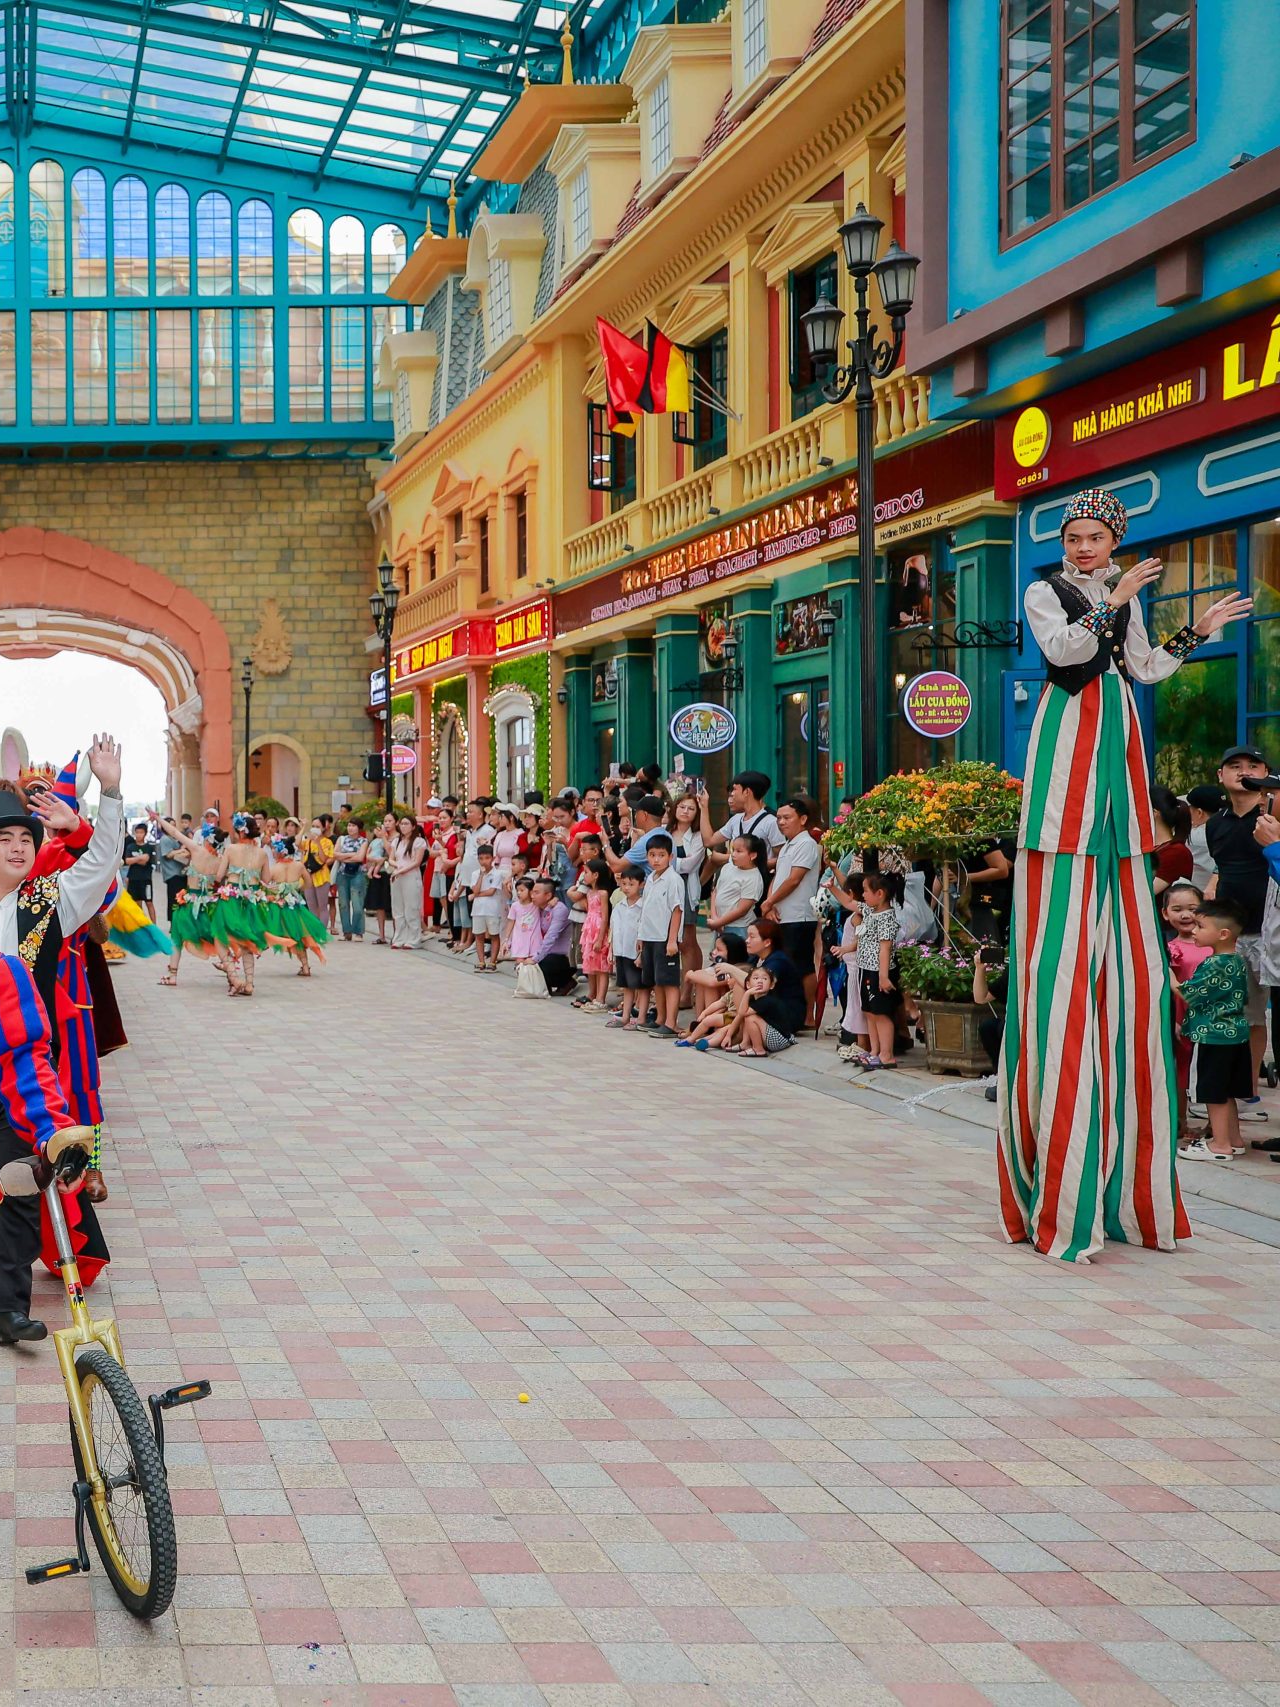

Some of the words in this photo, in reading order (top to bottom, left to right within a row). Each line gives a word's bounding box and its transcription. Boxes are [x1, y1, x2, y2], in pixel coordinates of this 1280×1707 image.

[1073, 410, 1097, 442] NHÀ
[1100, 399, 1134, 432] HÀNG
[1138, 382, 1164, 418] KHẢ
[1037, 472, 1042, 480] 3
[761, 496, 814, 543] MAN
[763, 527, 820, 562] HAMBURGER
[828, 514, 857, 539] BEER
[874, 487, 924, 523] OTDOG
[898, 522, 911, 535] 0983
[922, 516, 933, 528] 232
[927, 696, 945, 708] CUA
[692, 732, 716, 742] BERLIN
[696, 739, 712, 747] MAN
